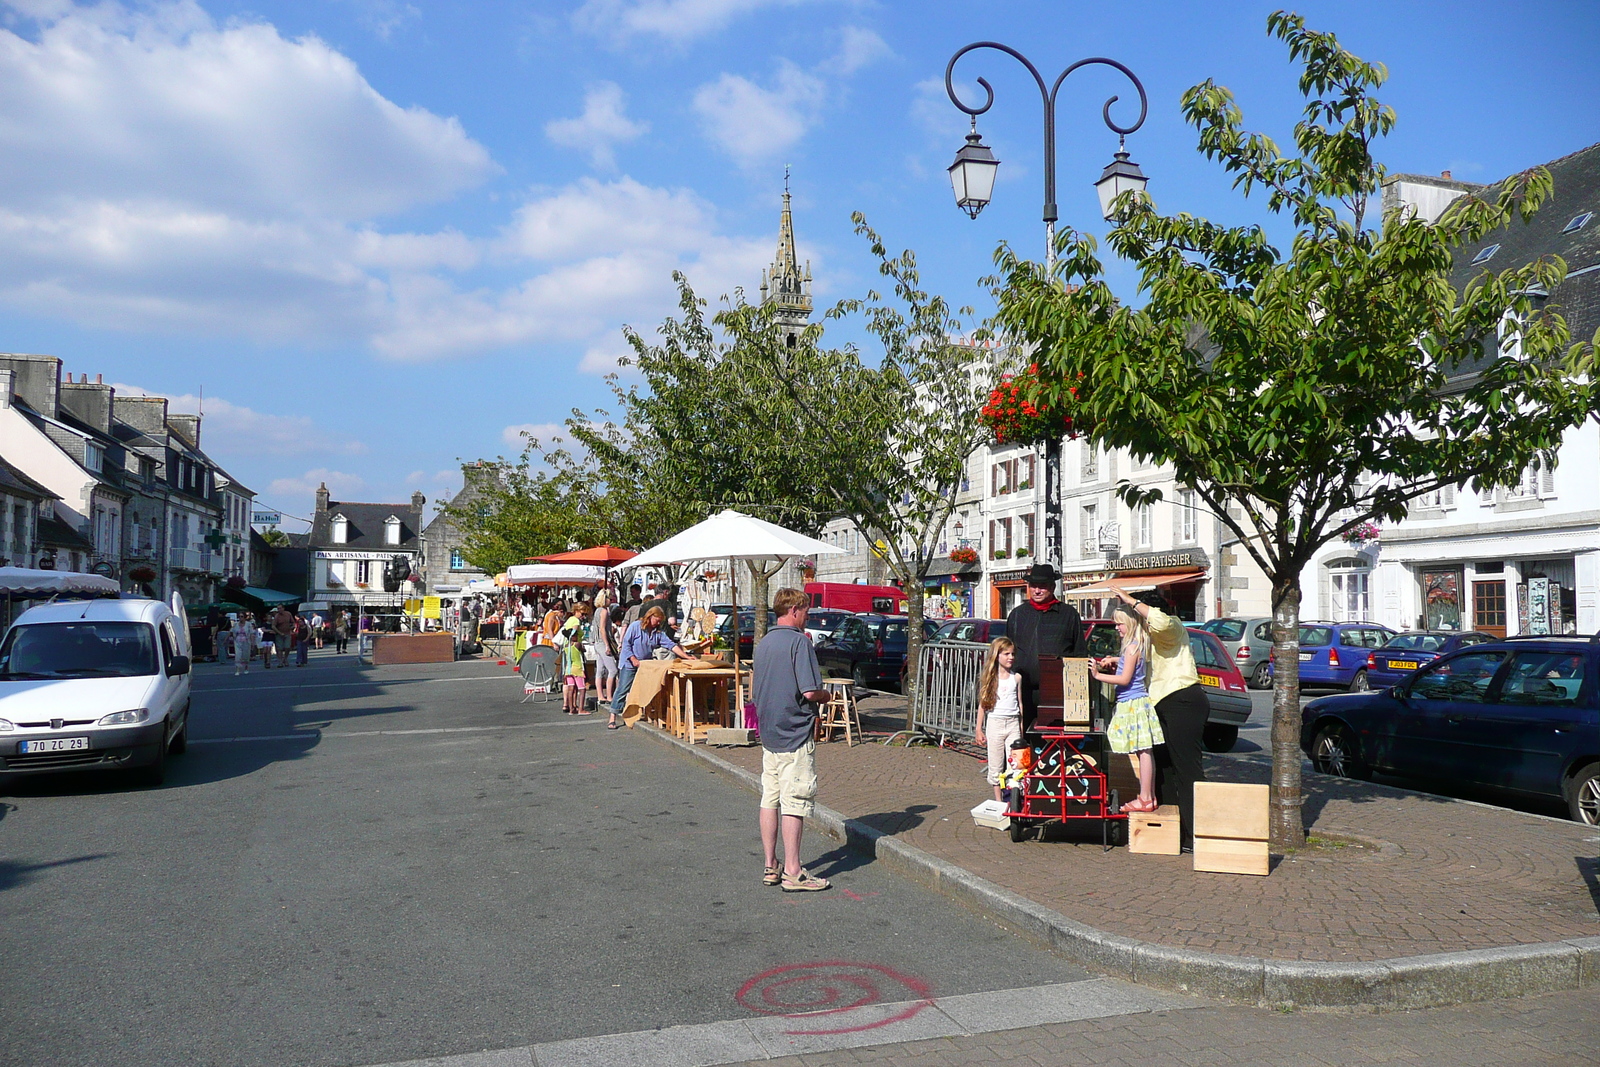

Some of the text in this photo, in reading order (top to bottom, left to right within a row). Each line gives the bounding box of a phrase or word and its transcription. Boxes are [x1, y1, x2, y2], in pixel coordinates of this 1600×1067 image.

[1105, 553, 1191, 570] BOULANGER PATISSIER
[1208, 677, 1216, 685] 29
[33, 739, 82, 751] 70 ZC 29
